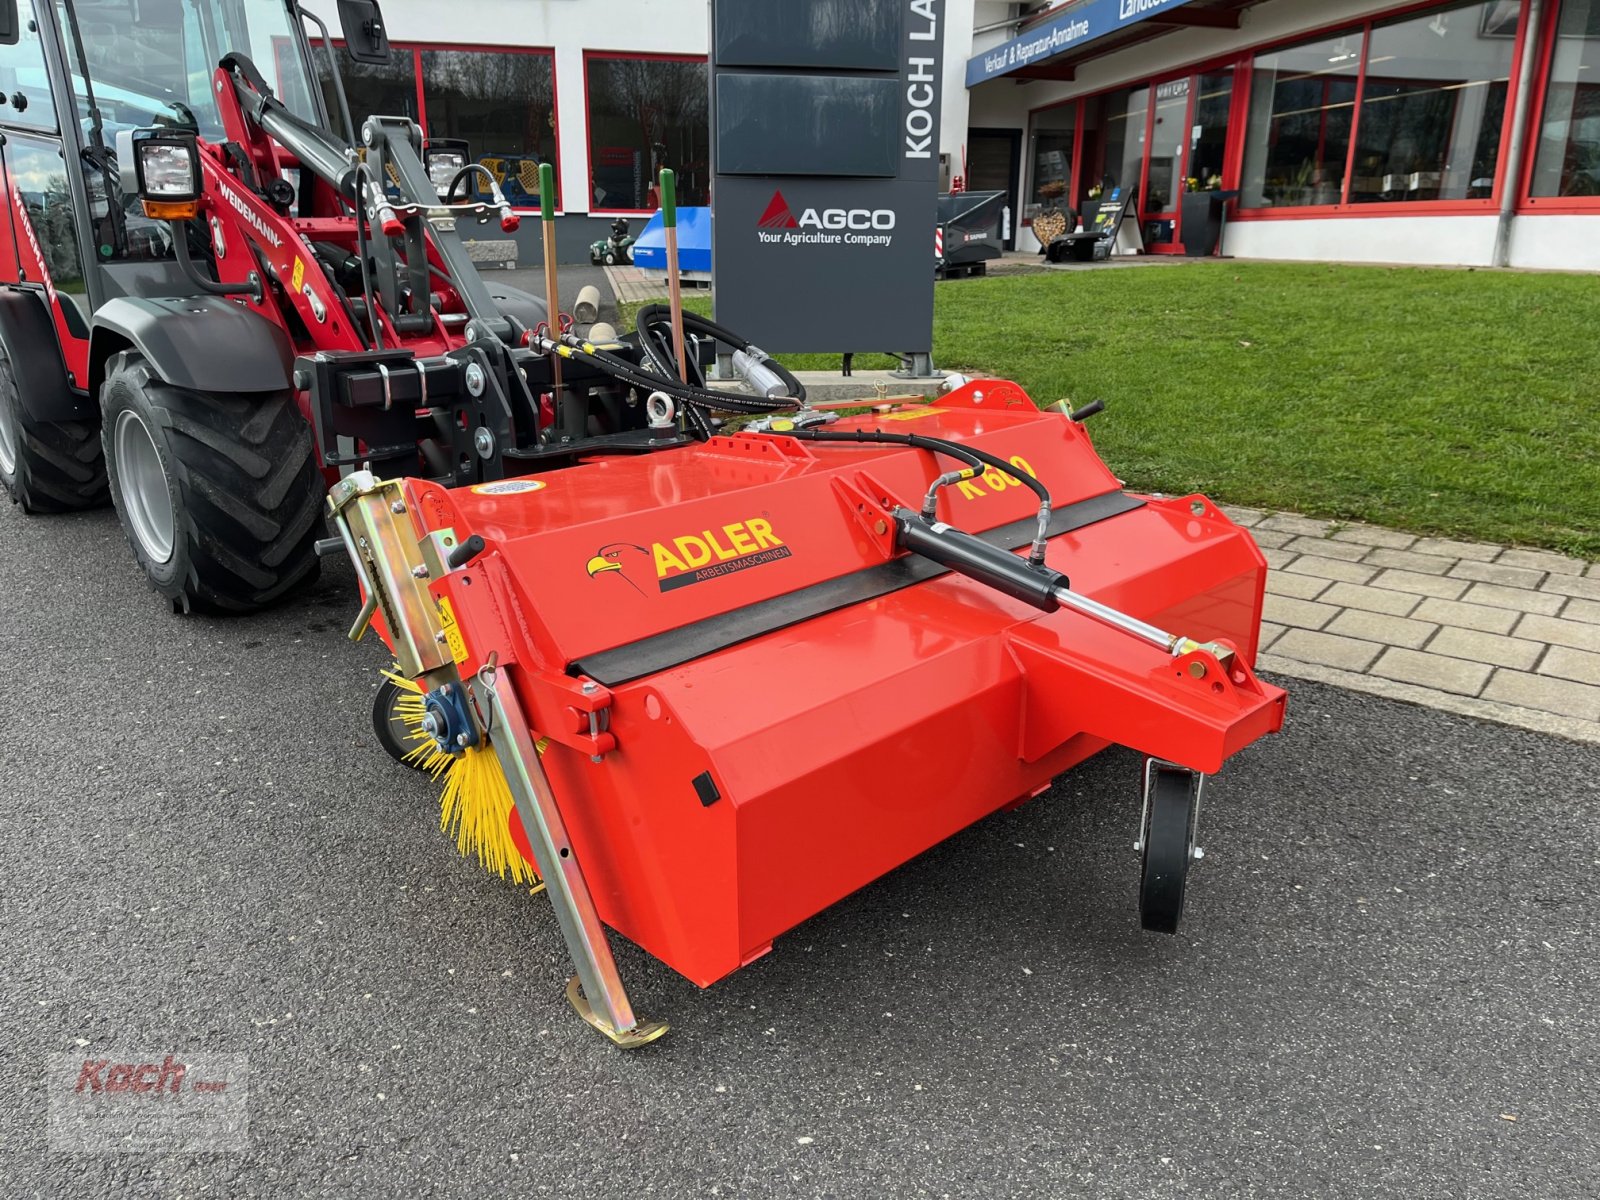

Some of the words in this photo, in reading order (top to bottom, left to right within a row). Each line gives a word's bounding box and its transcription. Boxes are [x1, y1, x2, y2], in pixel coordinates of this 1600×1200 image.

[984, 48, 1008, 73] Verkauf
[1009, 46, 1016, 64] &
[1016, 19, 1089, 65] Reparatur-Annahme
[905, 57, 935, 159] KOCH
[219, 179, 279, 248] WEIDEMANN
[758, 231, 782, 243] Your
[783, 231, 842, 246] Agriculture
[844, 232, 892, 247] Company
[798, 208, 896, 230] AGCO
[651, 517, 784, 578] ADLER
[695, 546, 790, 582] ARBEITSMASCHINEN
